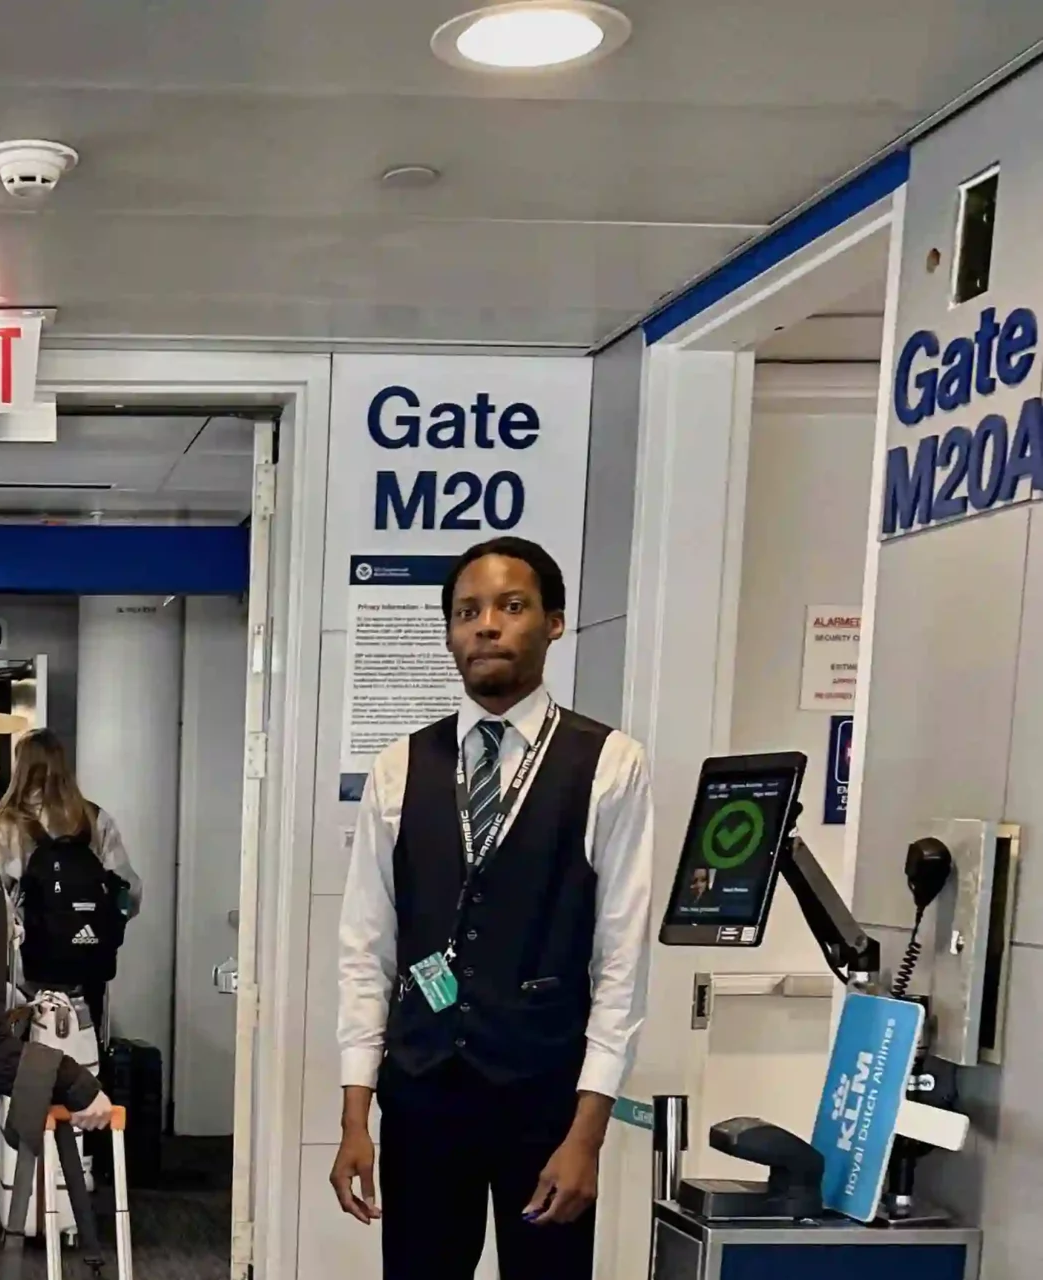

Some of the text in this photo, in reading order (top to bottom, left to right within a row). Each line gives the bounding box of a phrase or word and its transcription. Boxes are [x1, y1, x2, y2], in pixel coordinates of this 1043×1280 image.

[367, 385, 541, 450] Gate
[894, 306, 1038, 426] Gate
[374, 470, 526, 531] M20
[882, 397, 1043, 534] M20A
[836, 1051, 874, 1152] KLM
[844, 1017, 897, 1197] Royal Dutch Airlines
